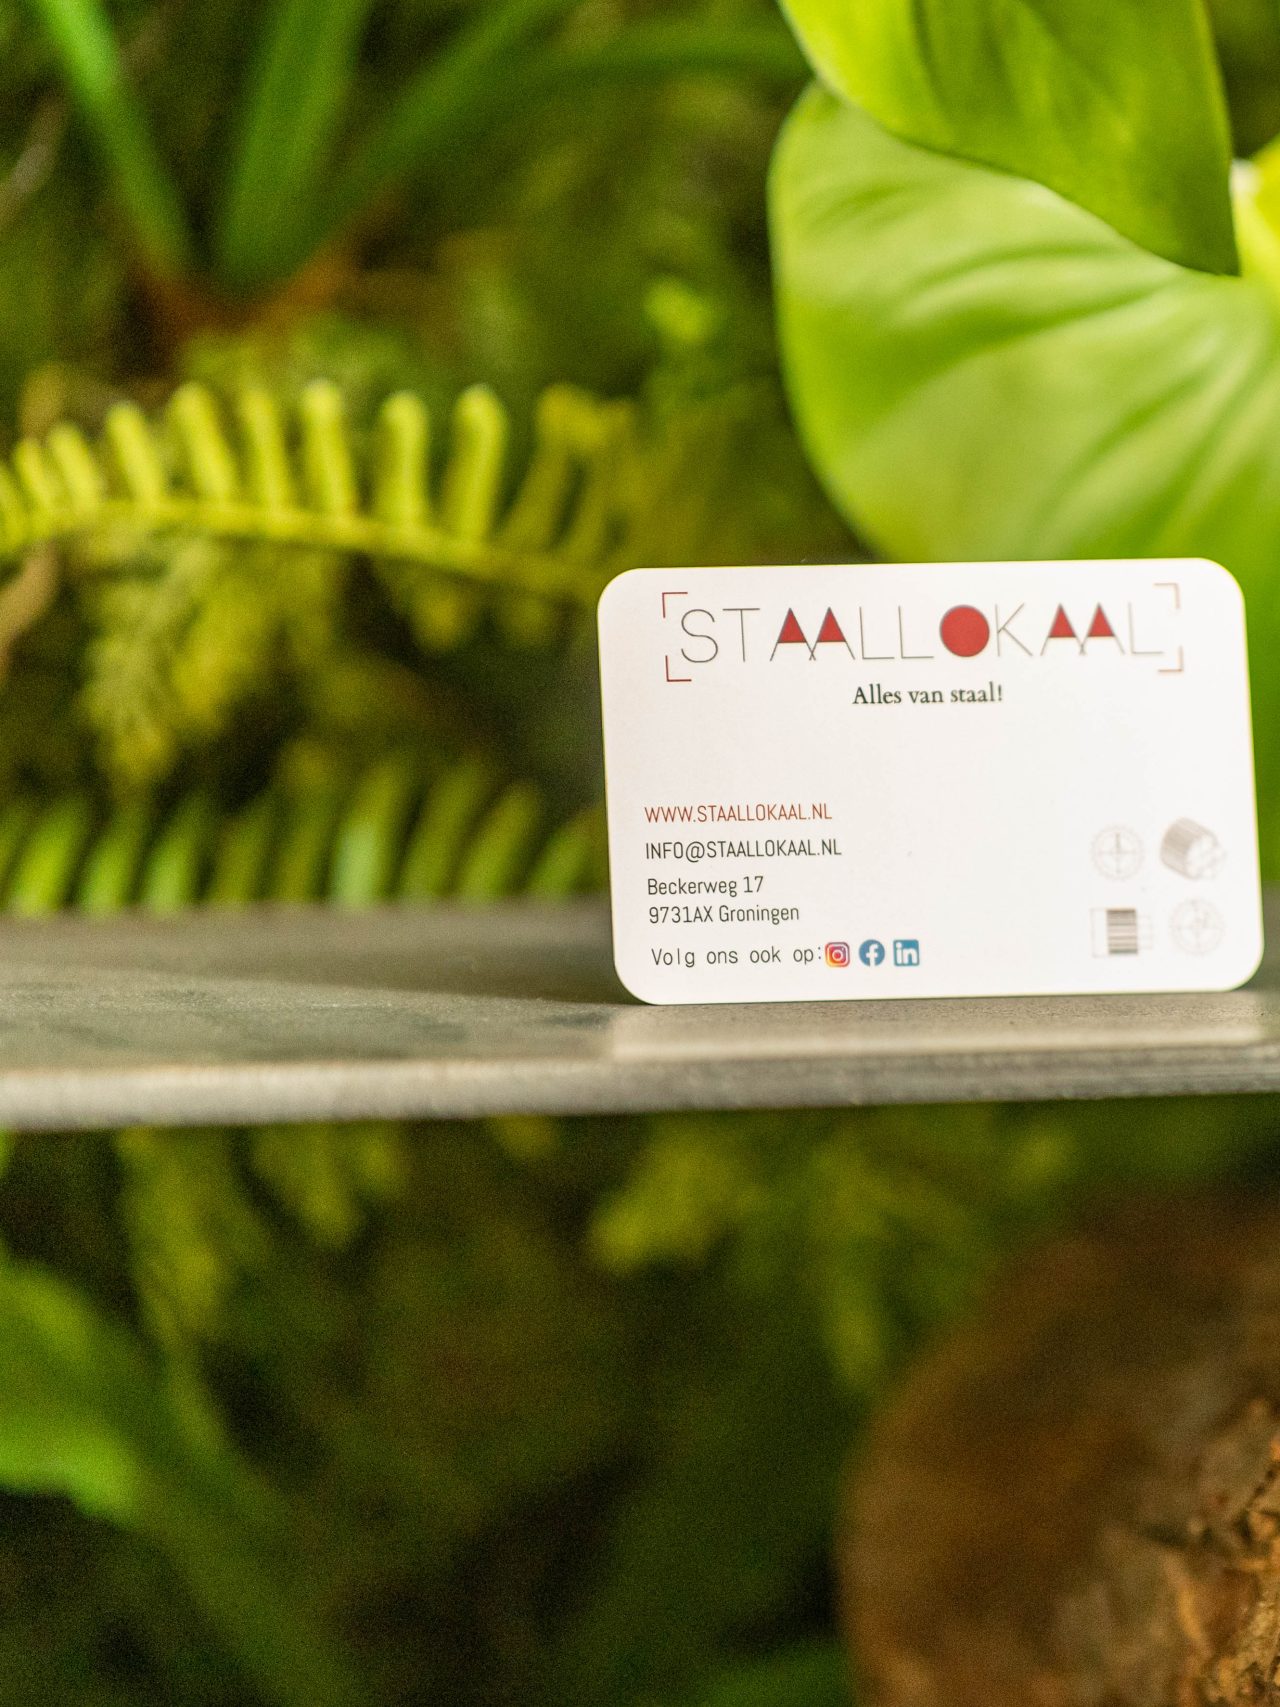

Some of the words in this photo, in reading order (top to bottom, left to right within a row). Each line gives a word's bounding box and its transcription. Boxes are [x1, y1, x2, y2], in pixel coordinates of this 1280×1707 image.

[679, 602, 1164, 664] STAALLOKAAL
[852, 682, 902, 706] Alles
[908, 688, 945, 705] van
[949, 683, 1004, 704] staal!
[644, 803, 833, 823] WWW.STAALLOKAAL.NL
[645, 838, 843, 863] INFO@STAALLOKAAL.NL
[647, 877, 738, 898] Beckerweg
[742, 875, 765, 894] 17
[649, 904, 714, 925] 9731AX
[718, 904, 801, 926] Groningen
[650, 947, 696, 968] Volg
[706, 950, 740, 965] ons
[749, 946, 782, 964] ook
